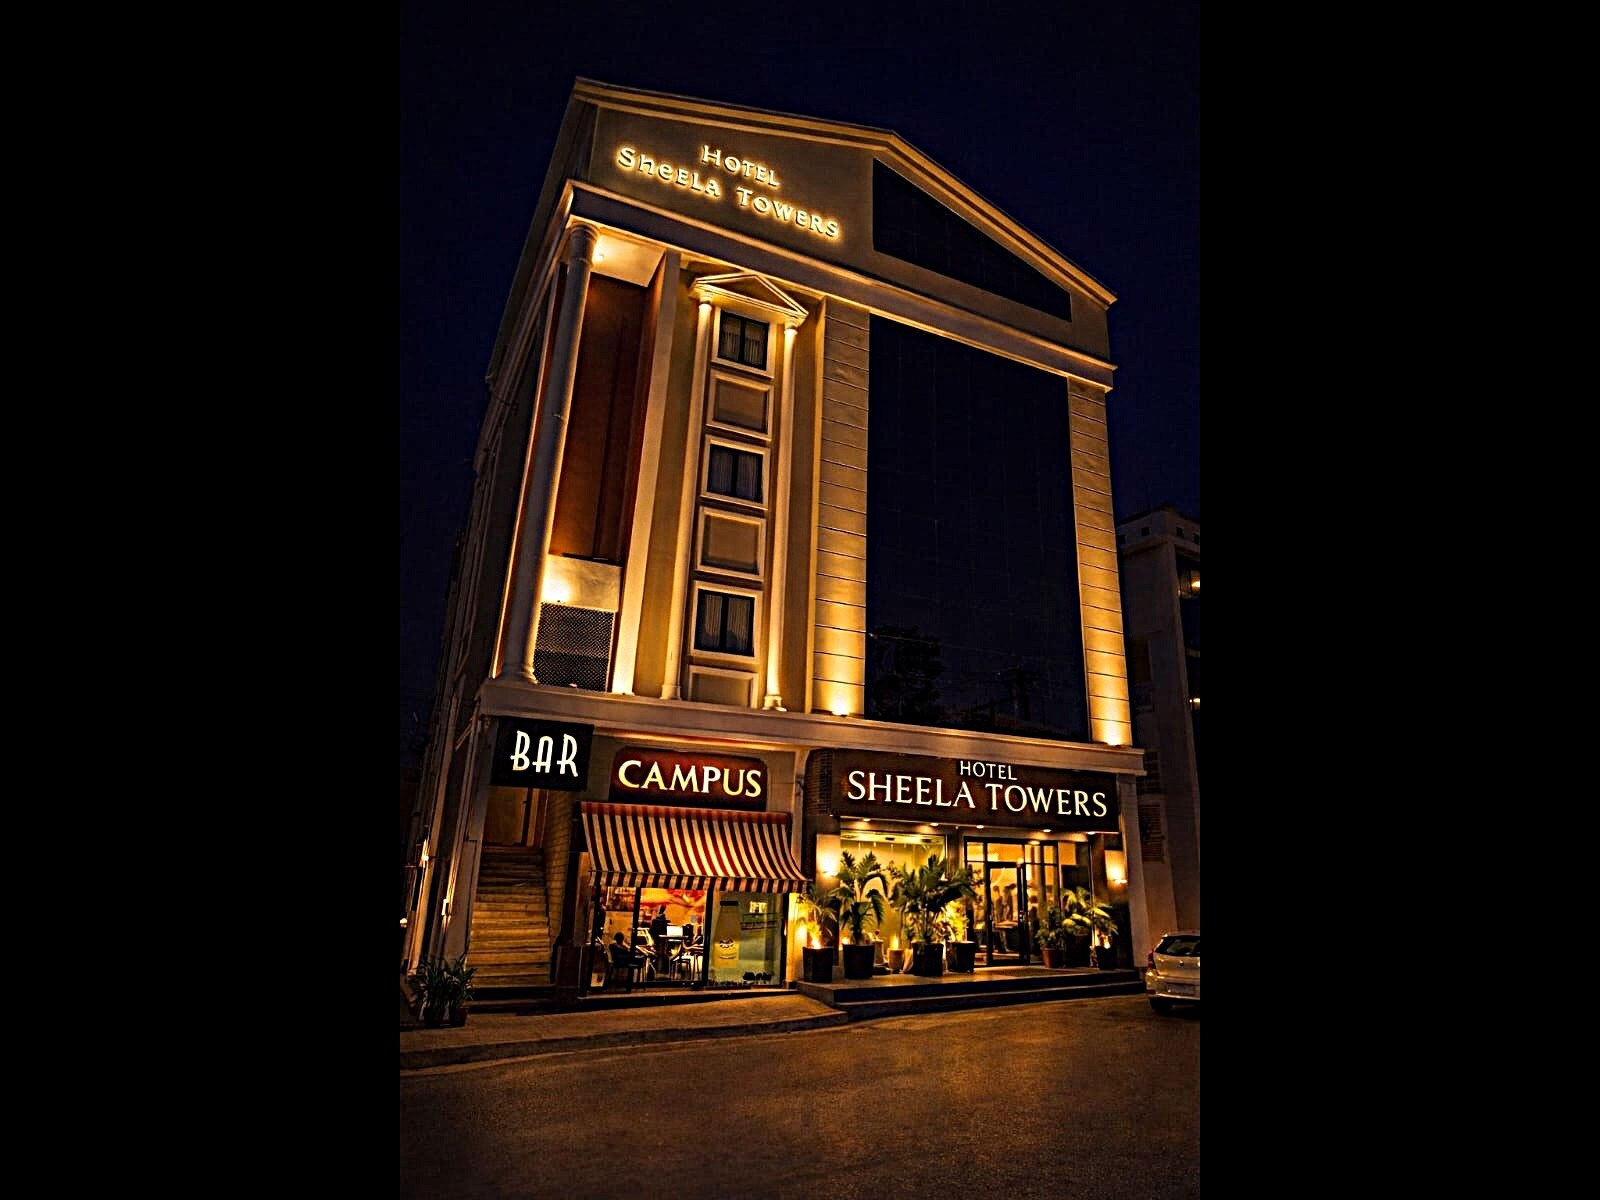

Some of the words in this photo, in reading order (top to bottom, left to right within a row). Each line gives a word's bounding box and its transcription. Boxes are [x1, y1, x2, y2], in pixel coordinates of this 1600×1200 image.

[703, 145, 780, 187] HOTEL
[736, 187, 839, 238] TOWERS
[510, 730, 578, 777] BAR
[959, 760, 1018, 781] HOTEL
[618, 759, 762, 797] CAMPUS
[847, 770, 976, 809] SHEELA
[985, 783, 1107, 817] TOWERS
